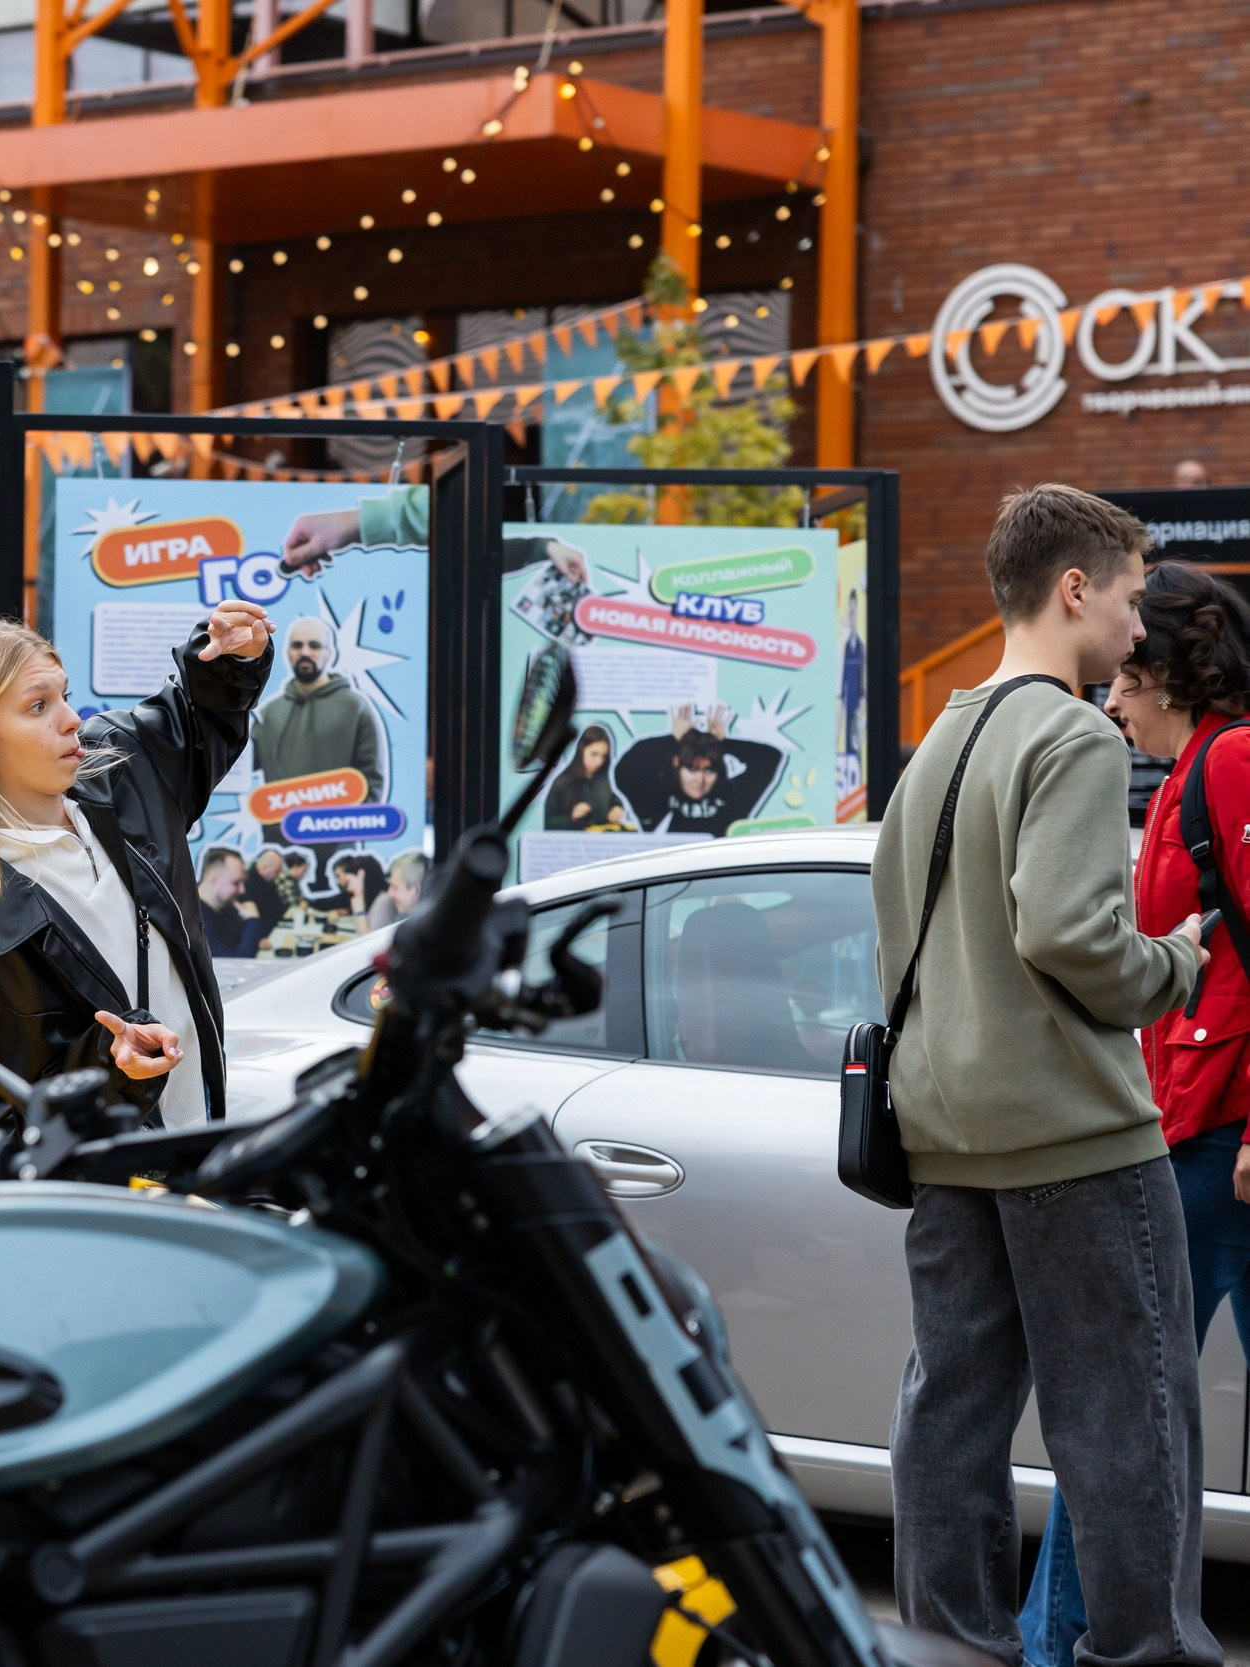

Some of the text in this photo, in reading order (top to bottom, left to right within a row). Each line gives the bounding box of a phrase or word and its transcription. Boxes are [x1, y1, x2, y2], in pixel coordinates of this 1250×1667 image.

[1134, 516, 1250, 550] ормация
[122, 534, 214, 567] ИГРА
[201, 554, 288, 605] ГО
[671, 556, 794, 587] Коллажный
[676, 592, 763, 623] КЛУБ
[588, 606, 807, 659] НОВАЯ ПЛОСКОСТЬ
[266, 780, 348, 812] ХАЧИК
[297, 814, 387, 833] Акопян
